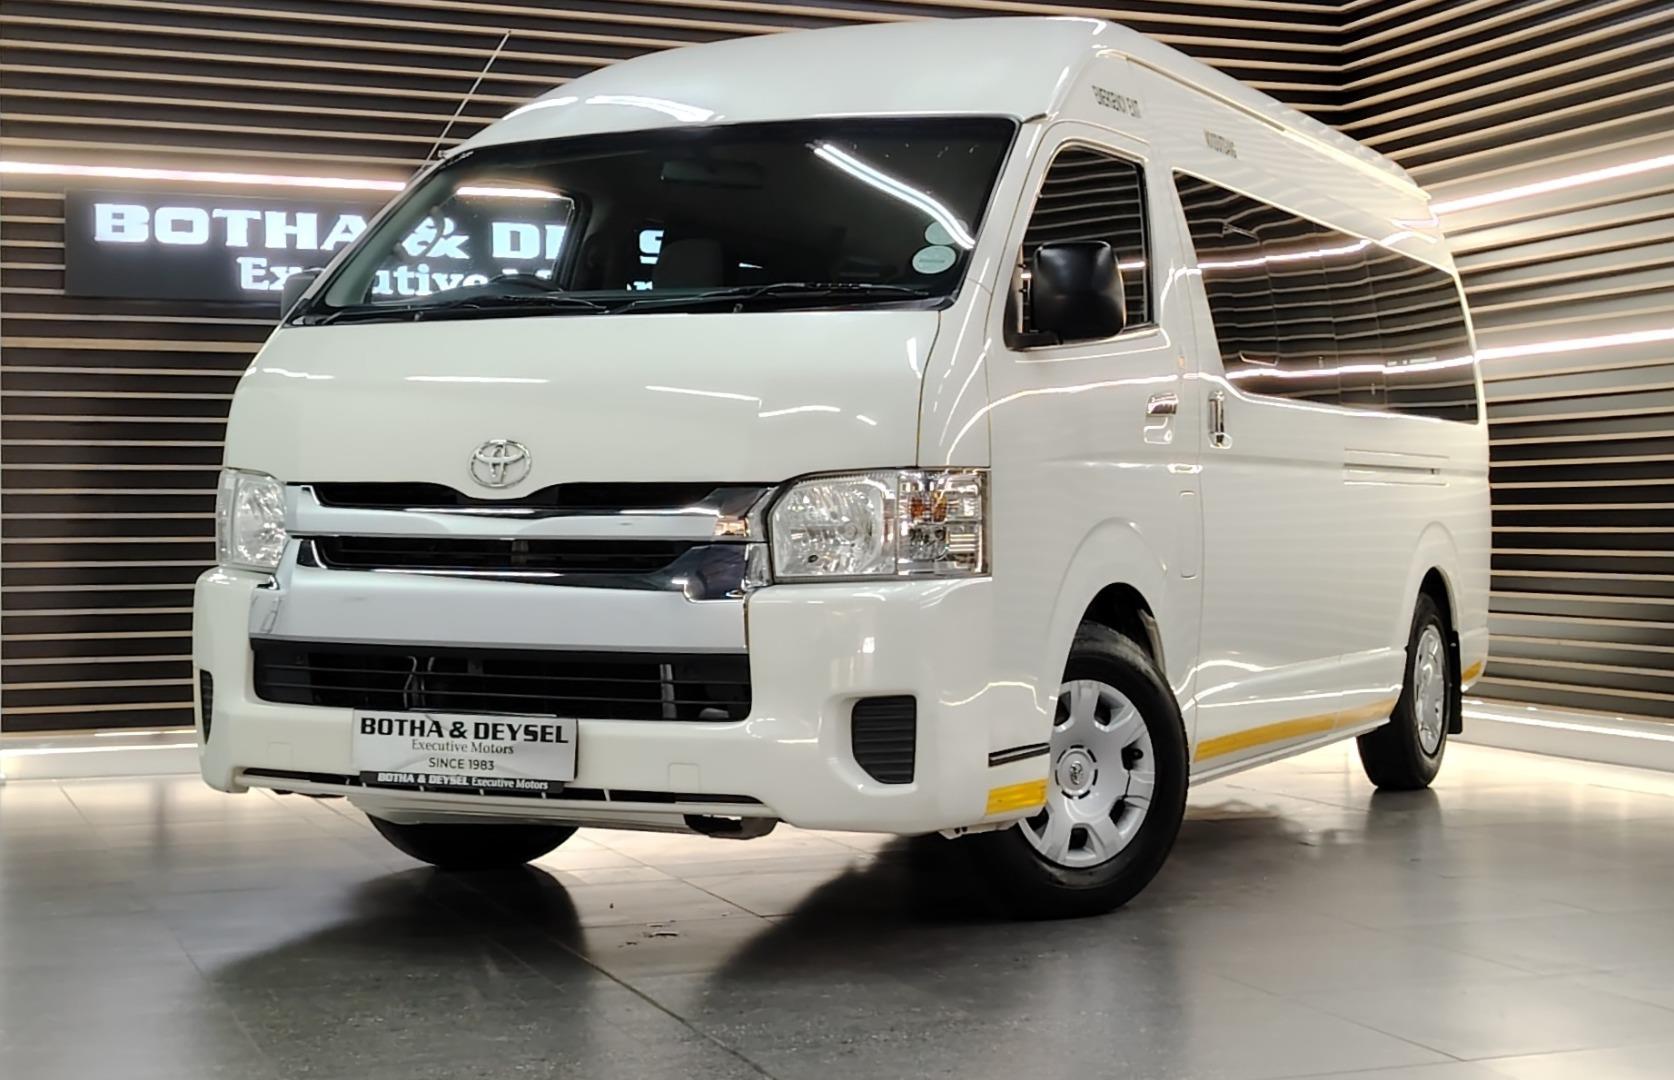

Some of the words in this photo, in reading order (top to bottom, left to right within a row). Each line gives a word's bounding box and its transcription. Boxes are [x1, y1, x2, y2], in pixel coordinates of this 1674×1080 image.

[94, 203, 367, 251] BOTHA
[401, 216, 470, 260] &
[361, 717, 444, 738] BOTHA
[449, 721, 468, 739] &
[474, 722, 569, 743] DEYSEL
[412, 739, 468, 753] Executive
[471, 741, 514, 755] Motors
[428, 757, 465, 769] SINCE
[468, 759, 495, 771] 1983
[377, 772, 415, 783] BOTHA
[417, 774, 426, 784] &
[428, 775, 470, 787] DEYSEL
[471, 777, 515, 789] Executive
[515, 779, 549, 791] Motors
